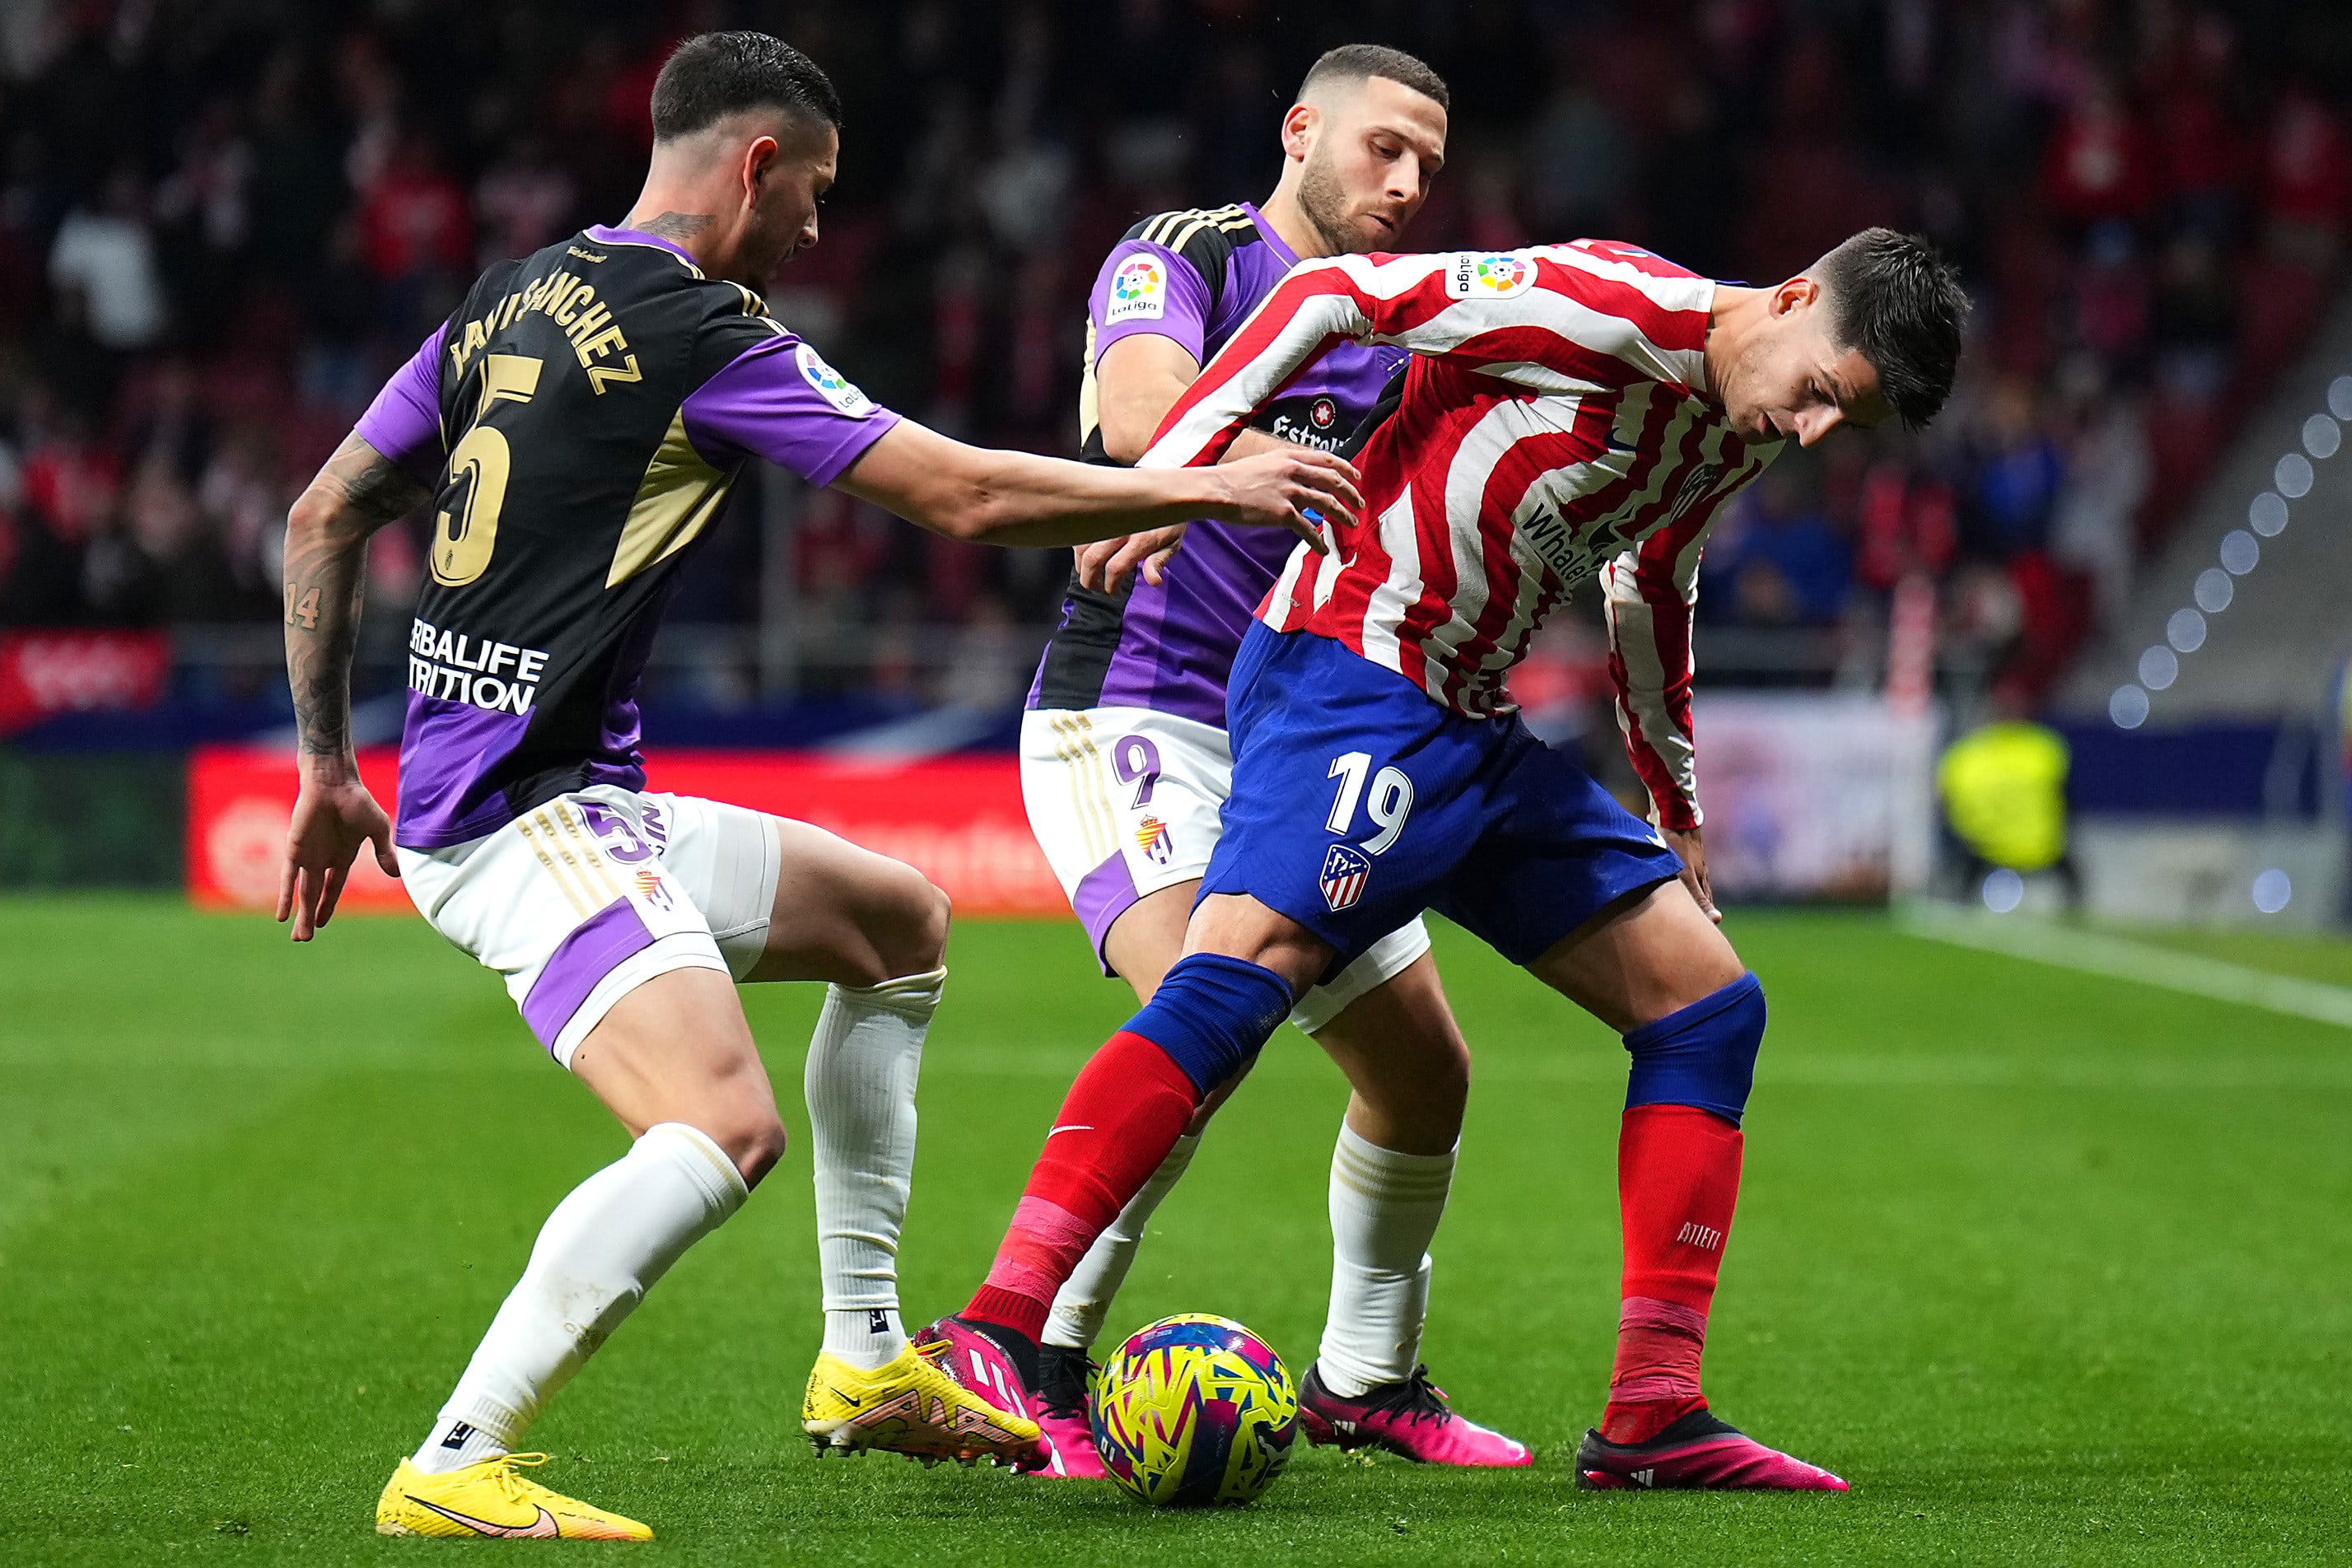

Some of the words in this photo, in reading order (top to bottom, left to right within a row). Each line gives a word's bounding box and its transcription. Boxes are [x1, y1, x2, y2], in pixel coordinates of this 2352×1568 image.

[1112, 300, 1157, 316] LaLiga
[429, 354, 544, 587] 5
[285, 581, 322, 631] 14
[409, 617, 550, 684] RBALIFE
[1111, 735, 1161, 810] 9
[1324, 751, 1414, 856] 19
[1676, 1221, 1722, 1251] ATLETI
